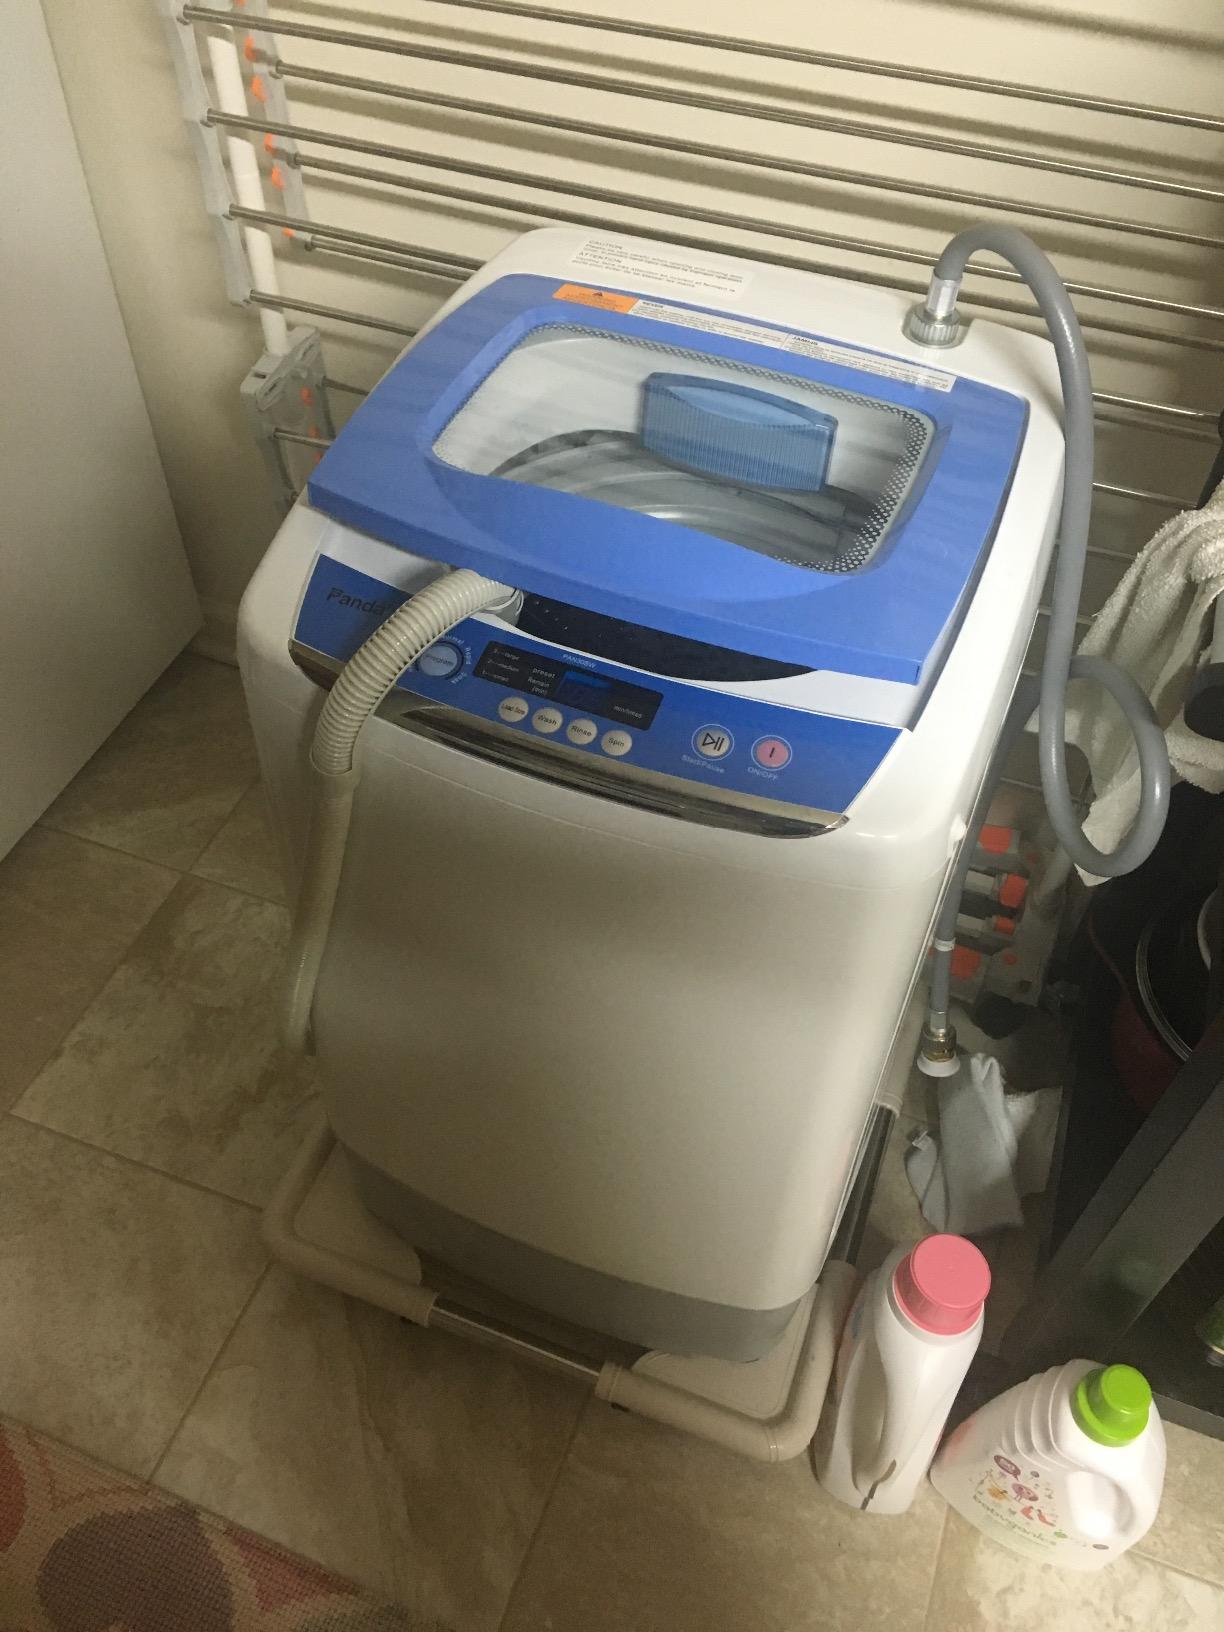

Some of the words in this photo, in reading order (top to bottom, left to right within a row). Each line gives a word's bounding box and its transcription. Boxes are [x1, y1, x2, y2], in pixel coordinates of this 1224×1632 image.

[537, 714, 558, 726] Wash
[570, 724, 592, 737] Rinse
[607, 737, 625, 748] Spin
[747, 766, 778, 780] ON/OFF
